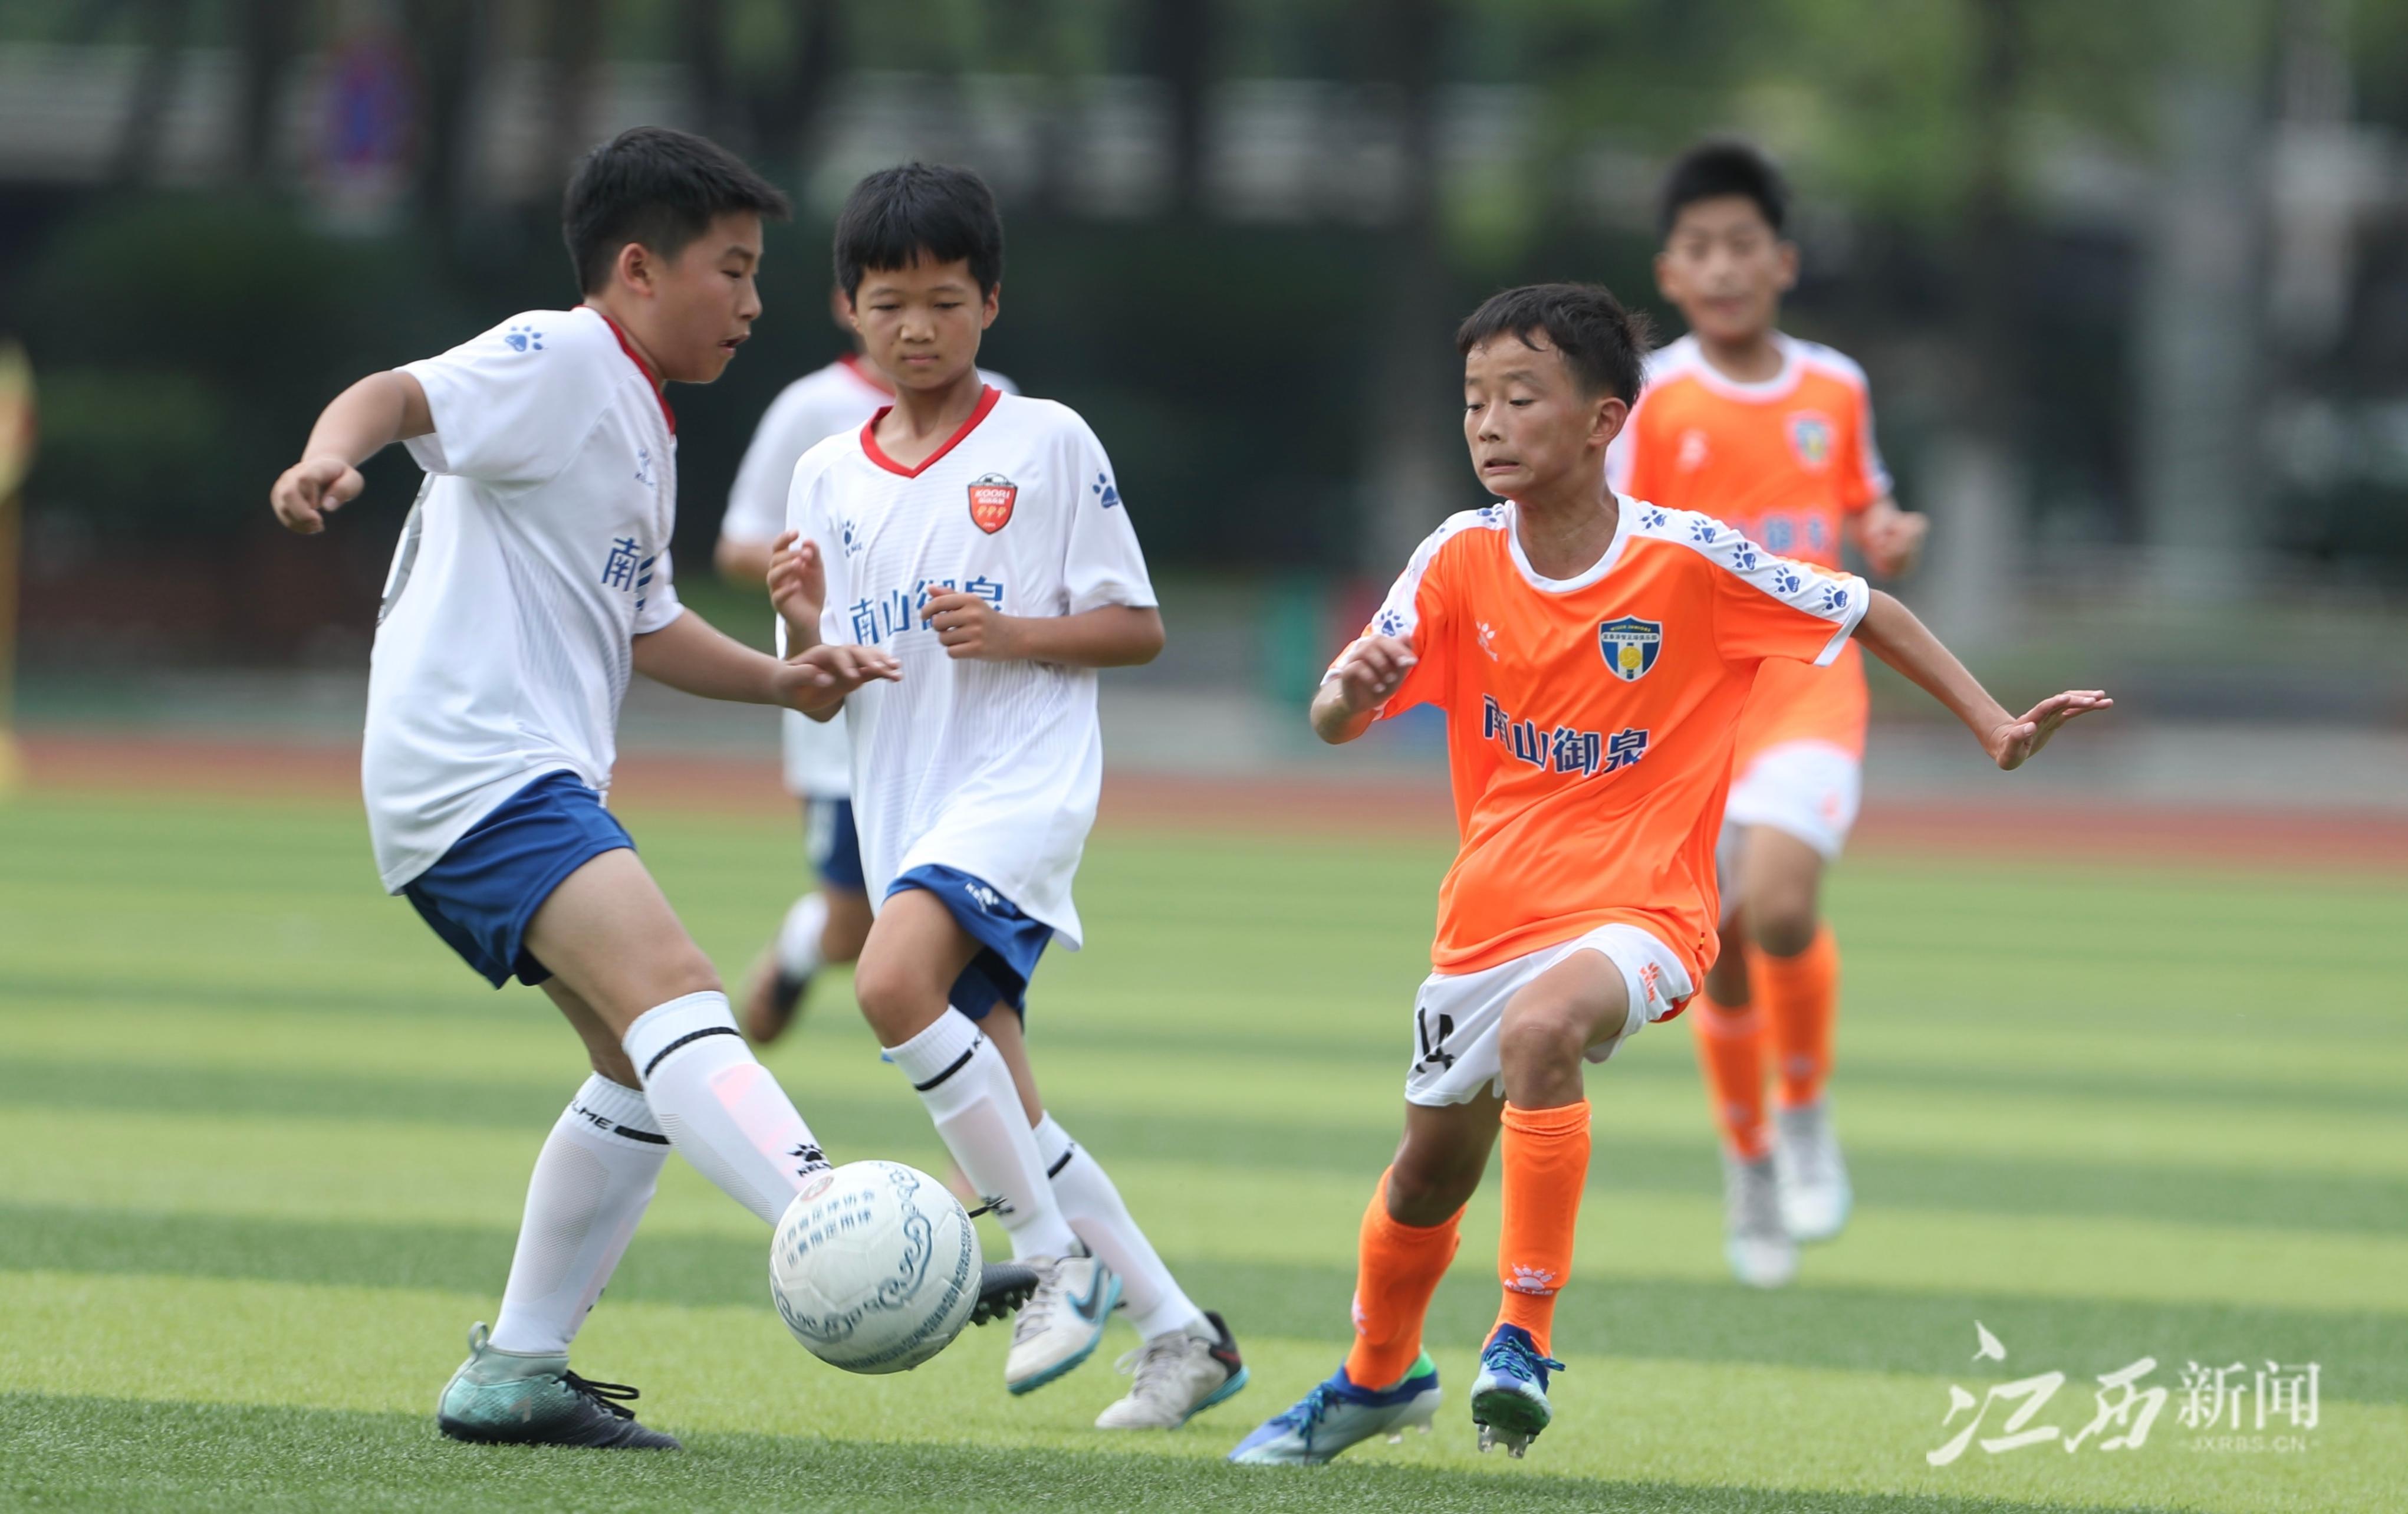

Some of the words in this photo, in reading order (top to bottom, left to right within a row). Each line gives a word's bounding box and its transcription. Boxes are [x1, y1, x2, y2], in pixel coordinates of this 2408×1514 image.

[1482, 693, 1650, 776] 南山御泉
[1504, 1278, 1554, 1296] KELME
